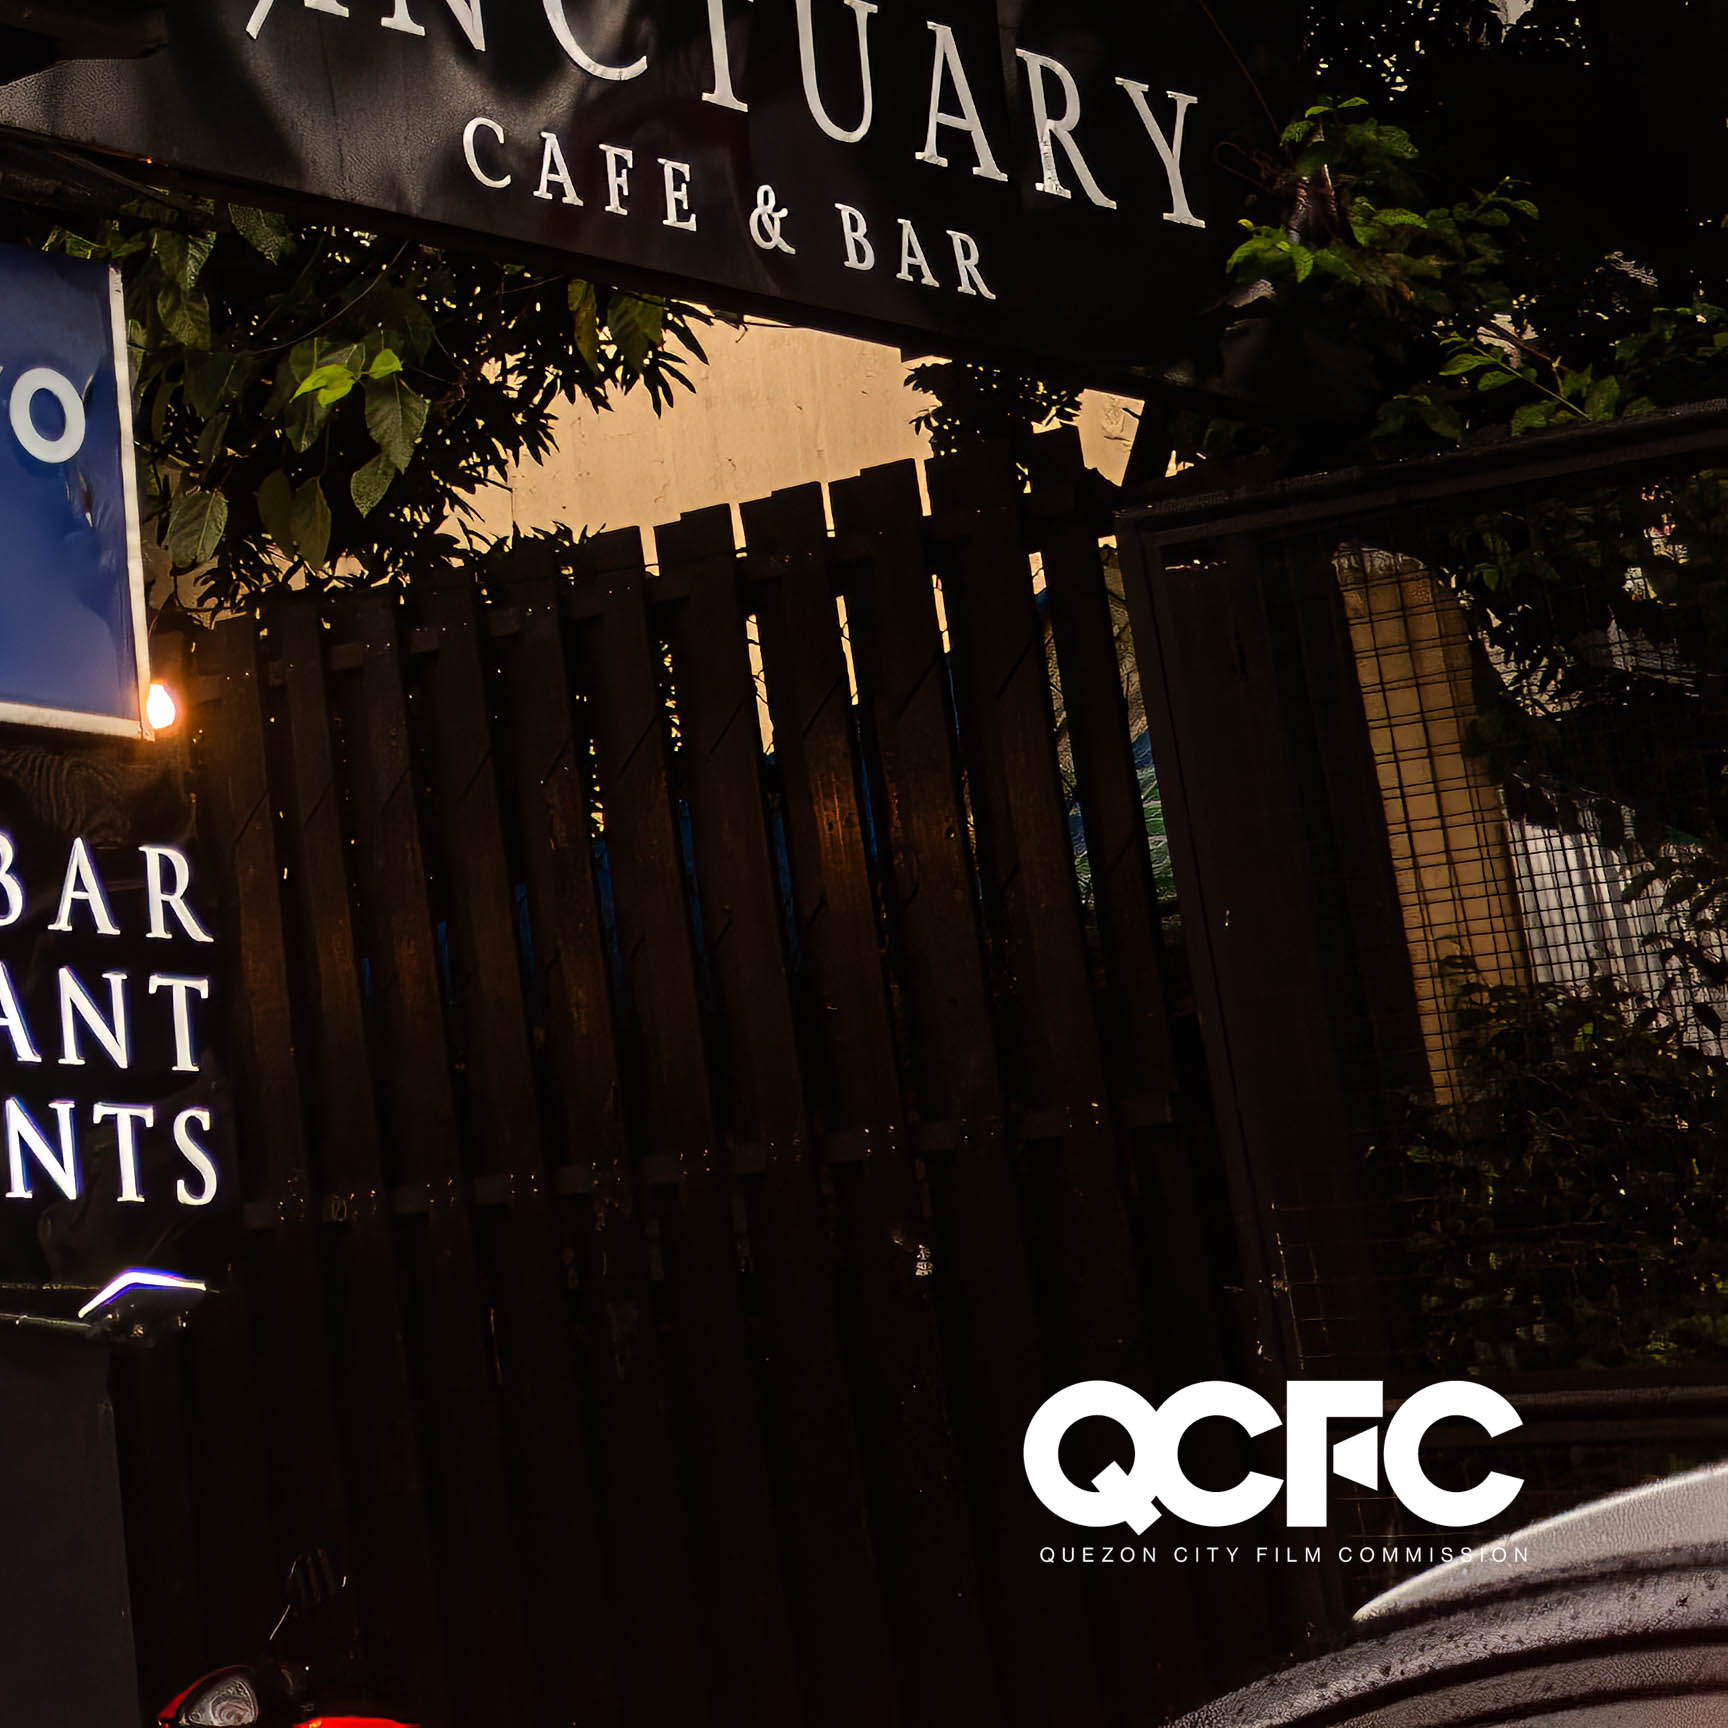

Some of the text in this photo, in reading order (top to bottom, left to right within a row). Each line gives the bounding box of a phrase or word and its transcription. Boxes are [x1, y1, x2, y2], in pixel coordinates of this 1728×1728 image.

[461, 116, 998, 301] CAFE & BAR
